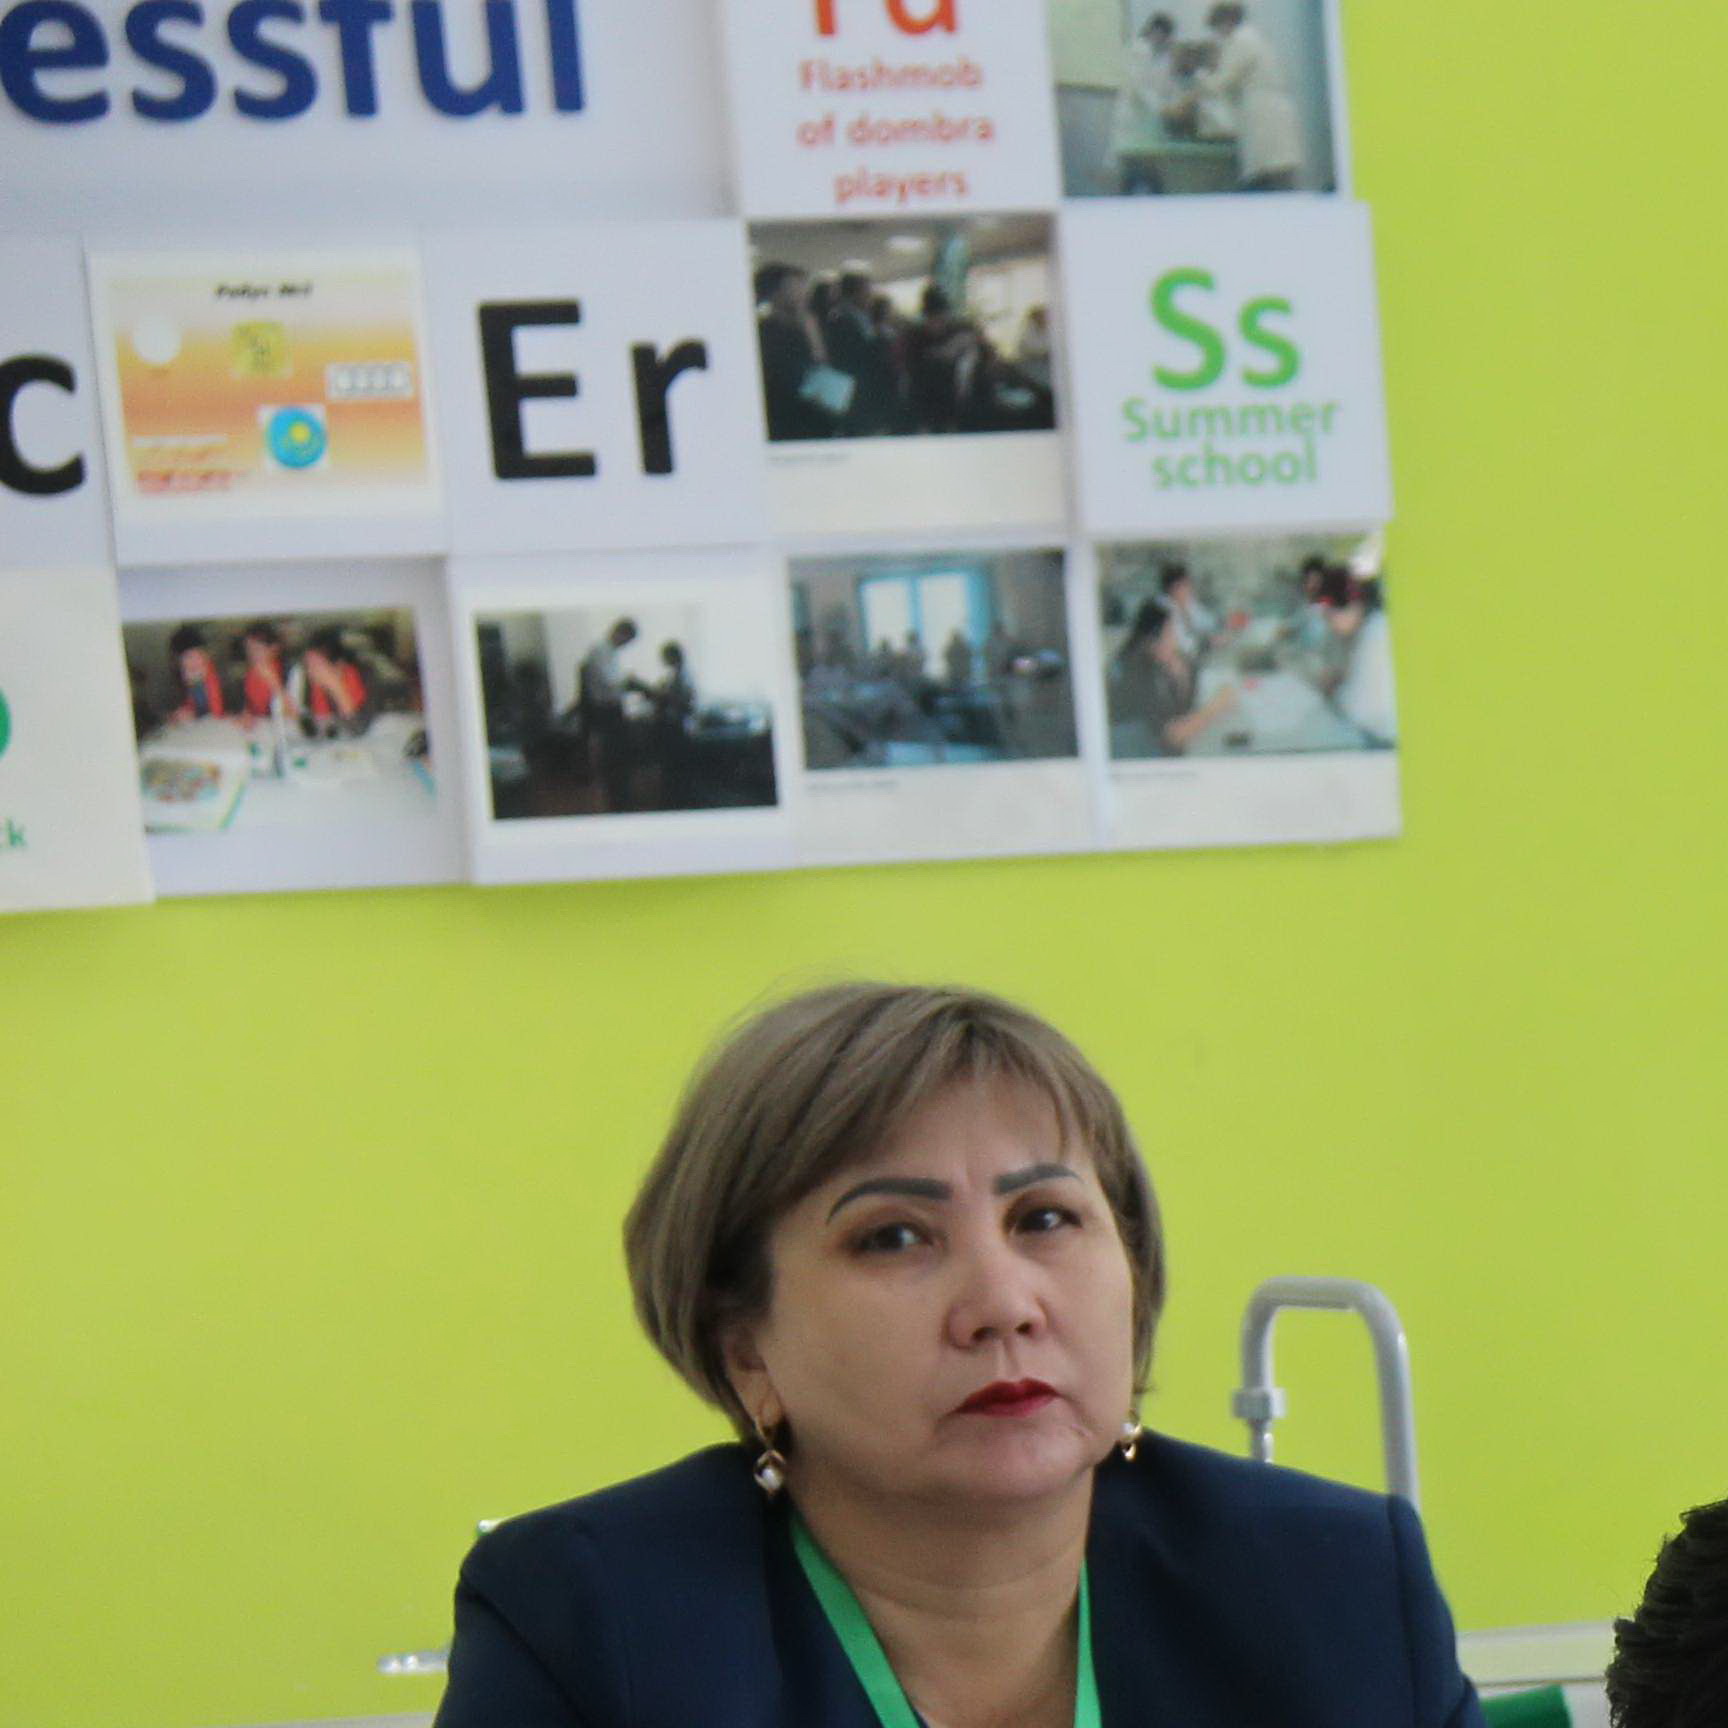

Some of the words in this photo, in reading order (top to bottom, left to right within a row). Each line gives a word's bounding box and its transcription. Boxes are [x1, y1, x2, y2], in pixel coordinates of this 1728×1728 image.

[799, 57, 984, 91] Flashmob
[798, 112, 836, 147] of
[848, 110, 994, 146] dombra
[834, 167, 969, 204] players
[1149, 266, 1302, 392] Ss
[478, 299, 710, 481] Er
[1121, 397, 1338, 443] Summer
[1151, 430, 1319, 490] school
